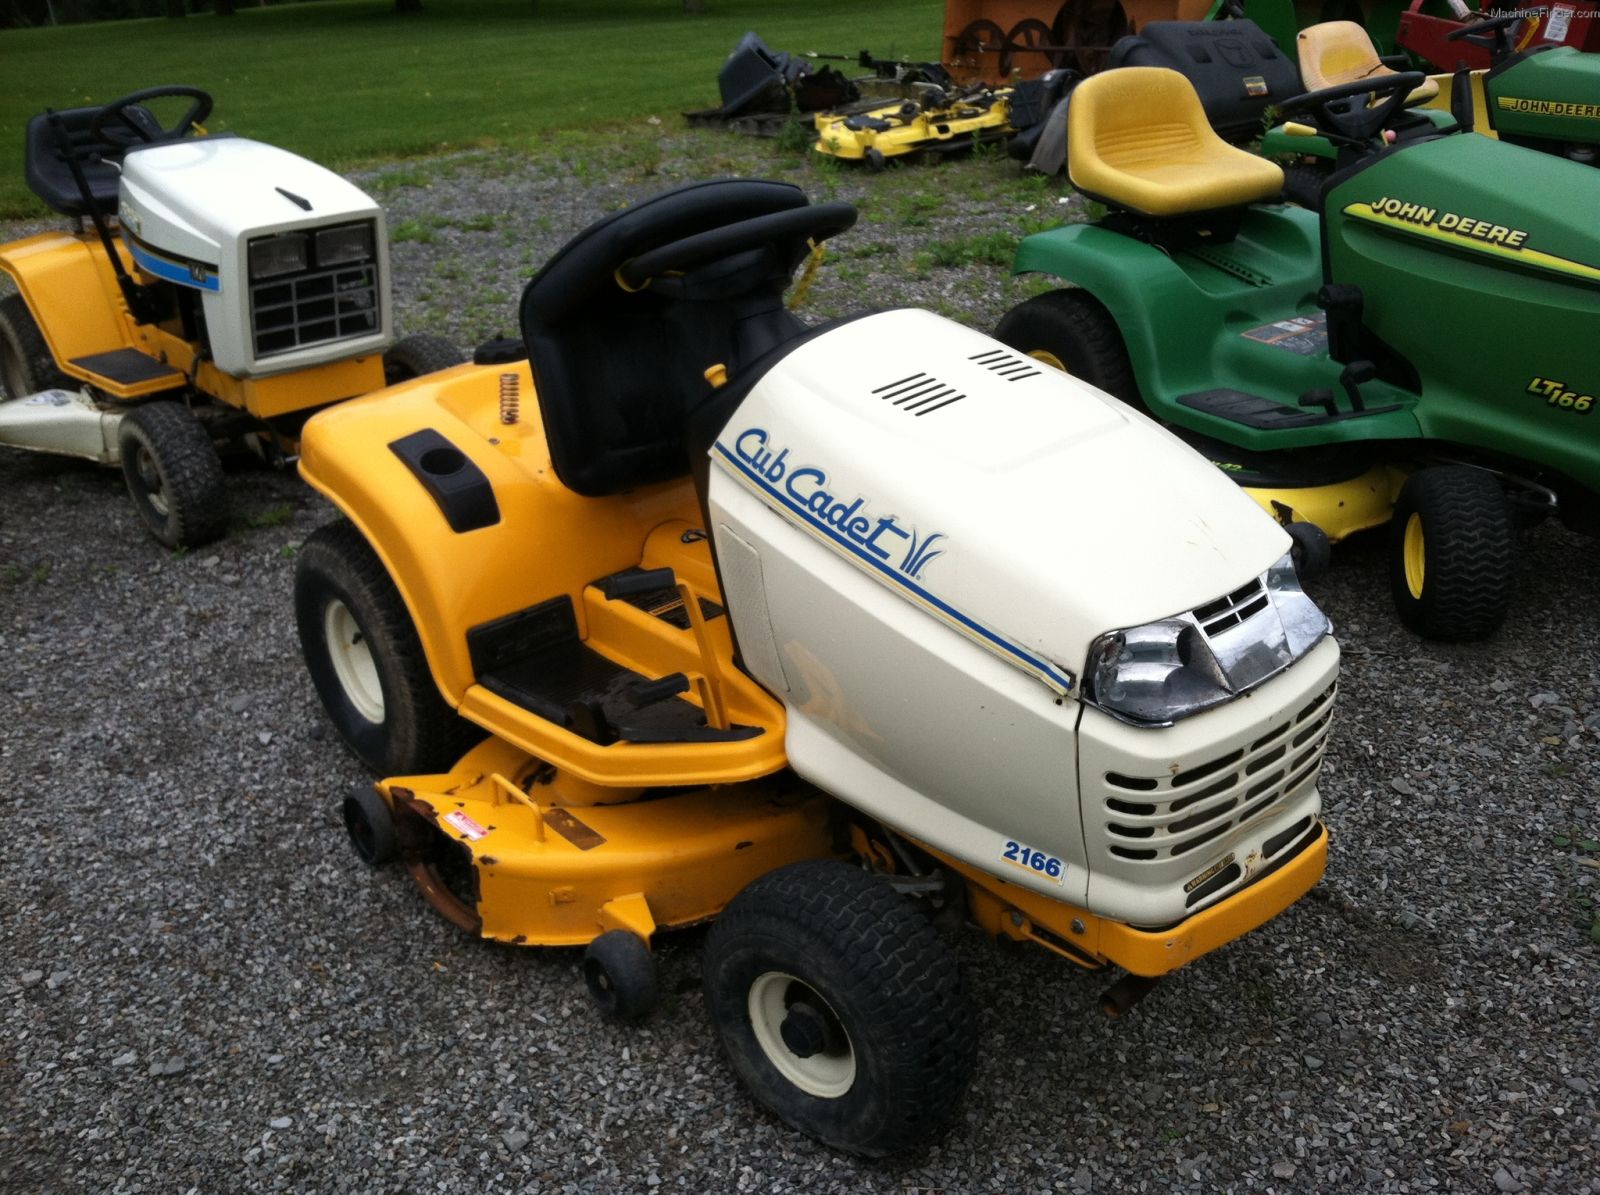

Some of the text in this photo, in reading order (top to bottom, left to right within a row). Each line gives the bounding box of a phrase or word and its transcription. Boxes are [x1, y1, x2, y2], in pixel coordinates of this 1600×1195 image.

[1511, 99, 1550, 113] JOHN
[1371, 196, 1528, 248] JOHN DEERE
[735, 428, 911, 561] Cub Cadet
[1003, 841, 1062, 878] 2166
